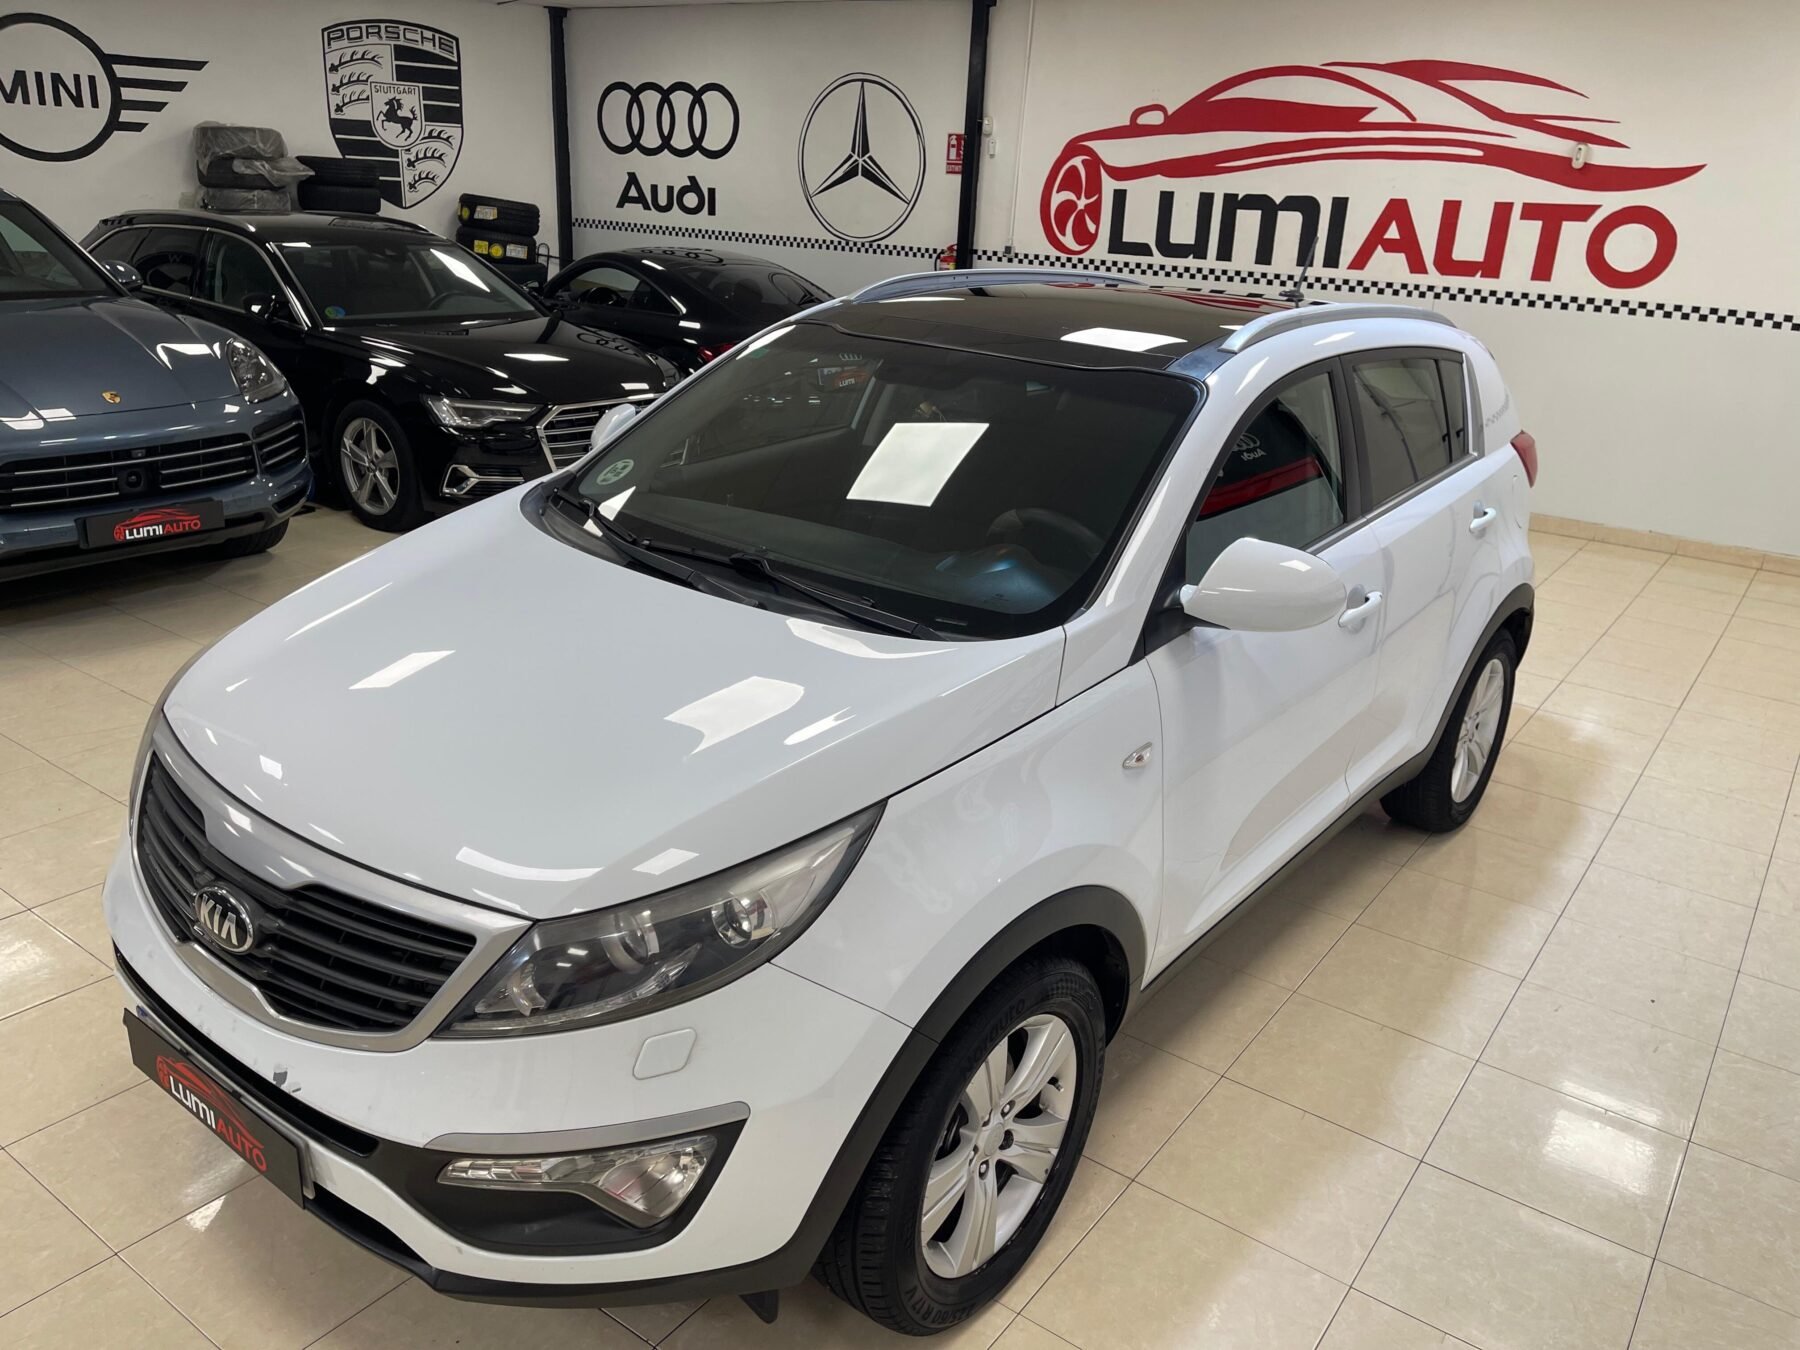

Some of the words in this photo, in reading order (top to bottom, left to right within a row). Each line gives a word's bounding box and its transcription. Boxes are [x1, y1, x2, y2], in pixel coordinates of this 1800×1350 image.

[327, 24, 455, 57] PORSCHE
[0, 70, 99, 109] MINI
[374, 84, 416, 96] STUTTGART
[200, 894, 239, 946] KIA
